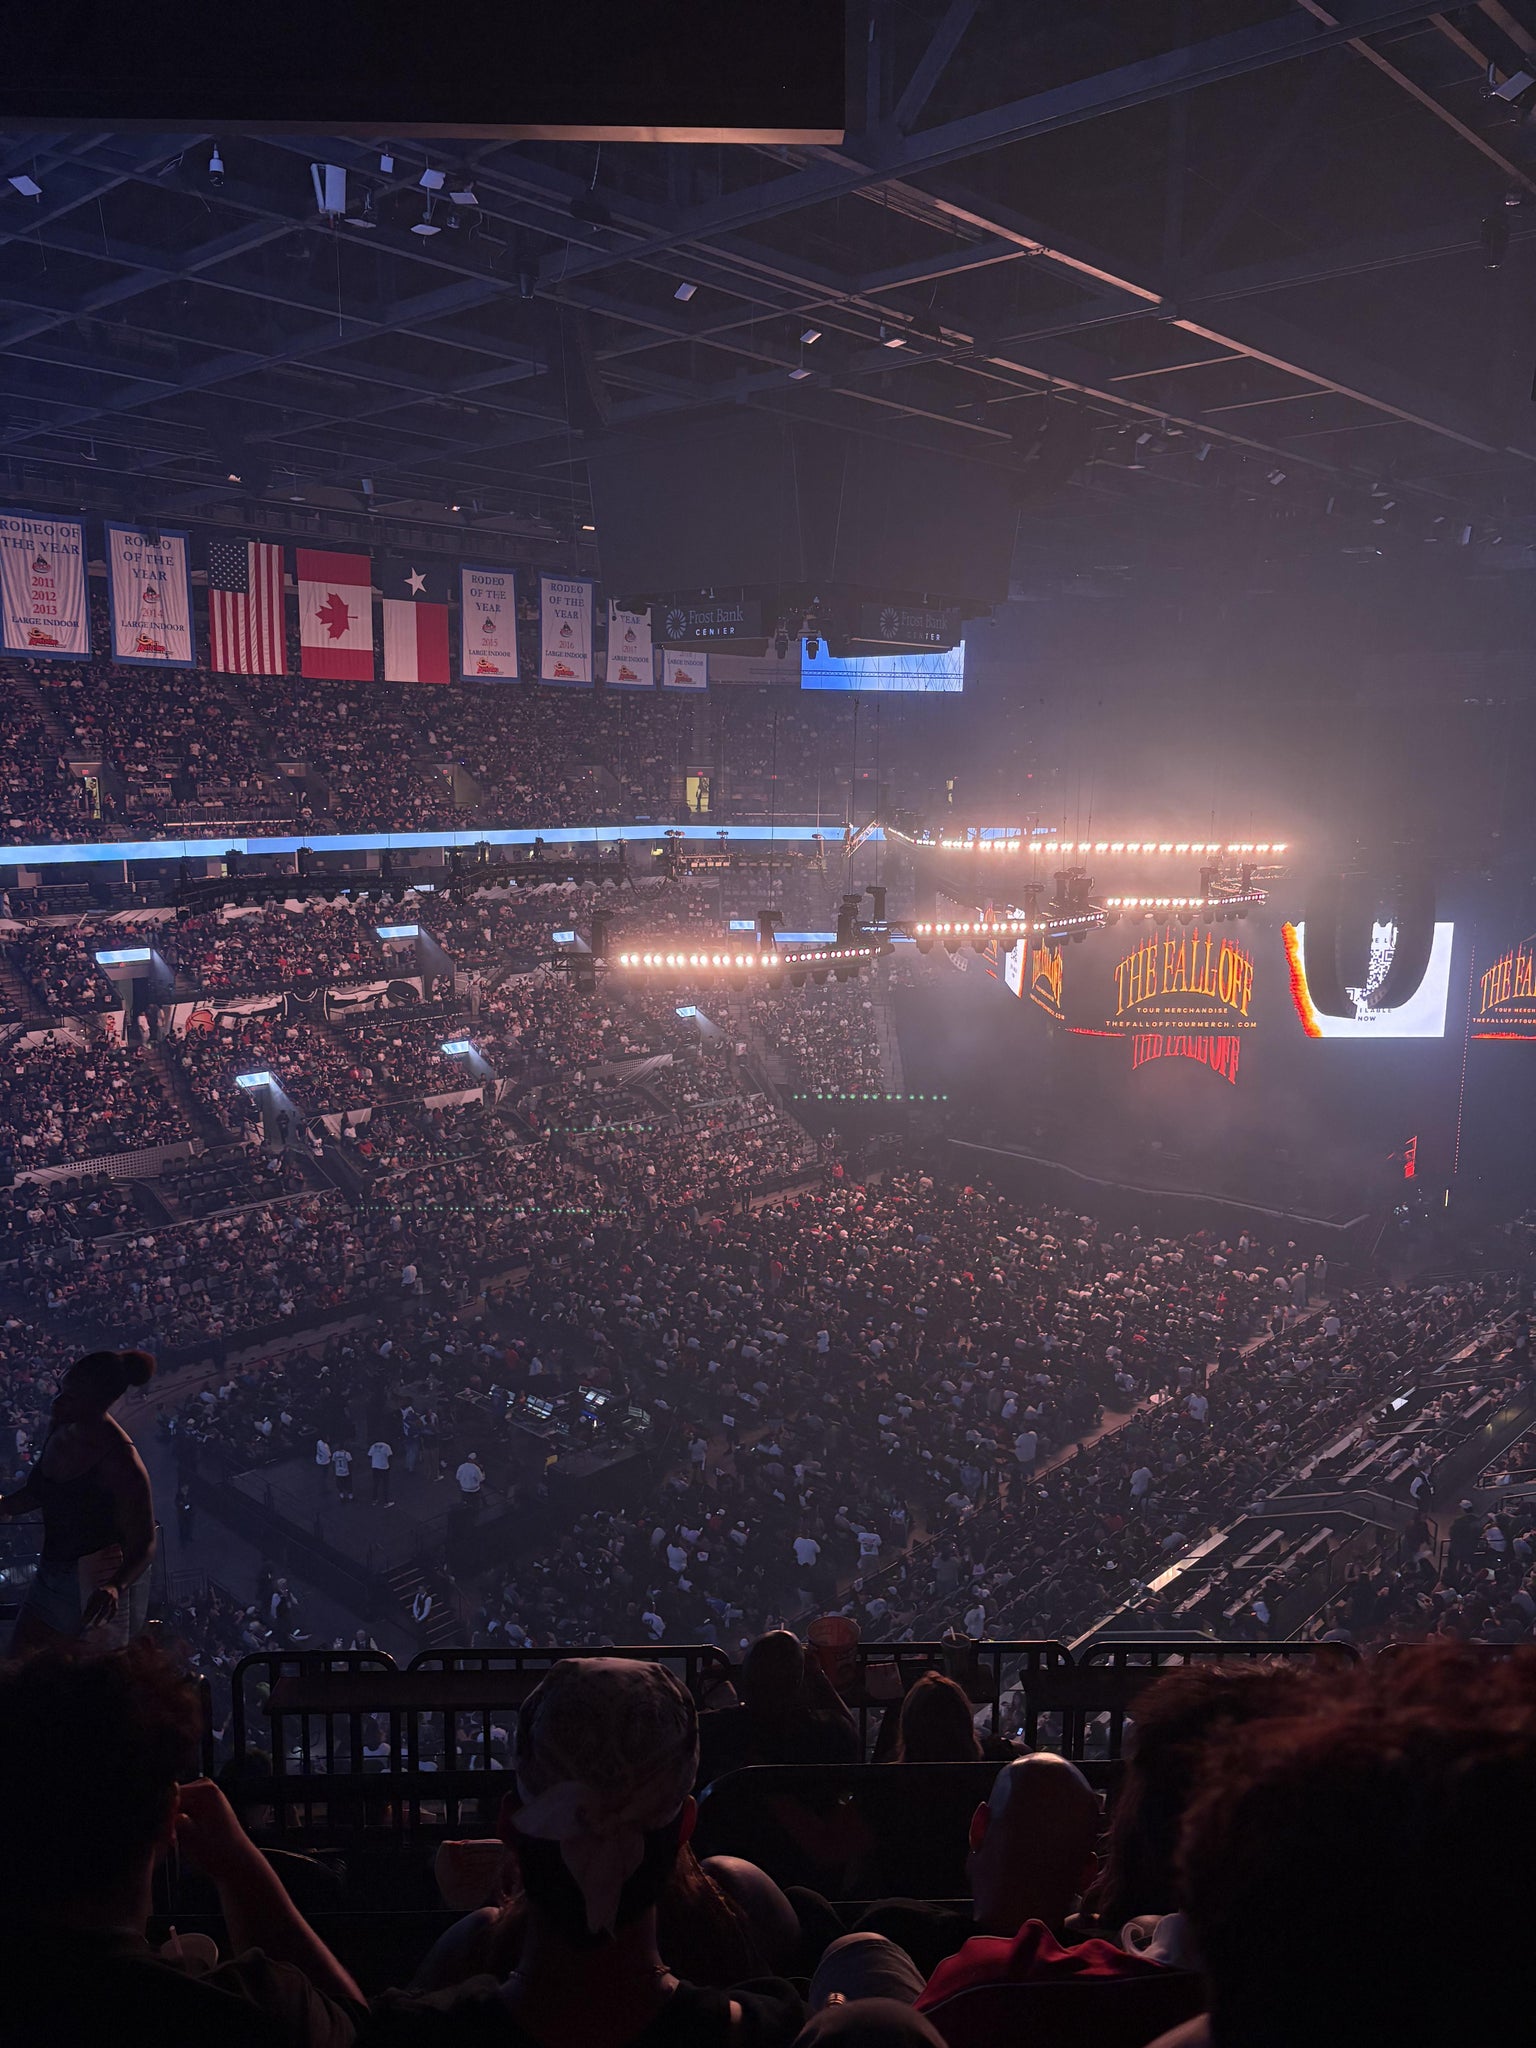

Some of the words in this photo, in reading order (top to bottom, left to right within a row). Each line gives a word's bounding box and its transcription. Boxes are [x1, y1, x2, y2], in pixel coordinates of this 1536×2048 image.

[0, 519, 54, 536] RODEO
[60, 526, 79, 538] OF
[1, 536, 35, 551] THE
[40, 541, 80, 555] YEAR
[123, 551, 142, 562] OF
[146, 554, 174, 566] THE
[132, 568, 168, 581] YEAR
[471, 574, 505, 586] RODEO
[32, 576, 55, 588] 2011
[470, 588, 483, 598] OF
[486, 590, 507, 600] THE
[550, 583, 584, 594] RODEO
[32, 590, 57, 602] 2012
[549, 595, 562, 605] OF
[564, 597, 585, 607] THE
[32, 603, 57, 615] 2013
[475, 602, 502, 613] YEAR
[554, 608, 579, 619] YEAR
[688, 610, 714, 624] Frost
[716, 605, 744, 623] Bank
[12, 616, 41, 625] LARGE
[43, 618, 80, 628] INDOOR
[121, 620, 149, 629] LARGE
[150, 622, 185, 632] INDOOR
[1114, 943, 1158, 1016] THE
[1480, 959, 1513, 1015] THE
